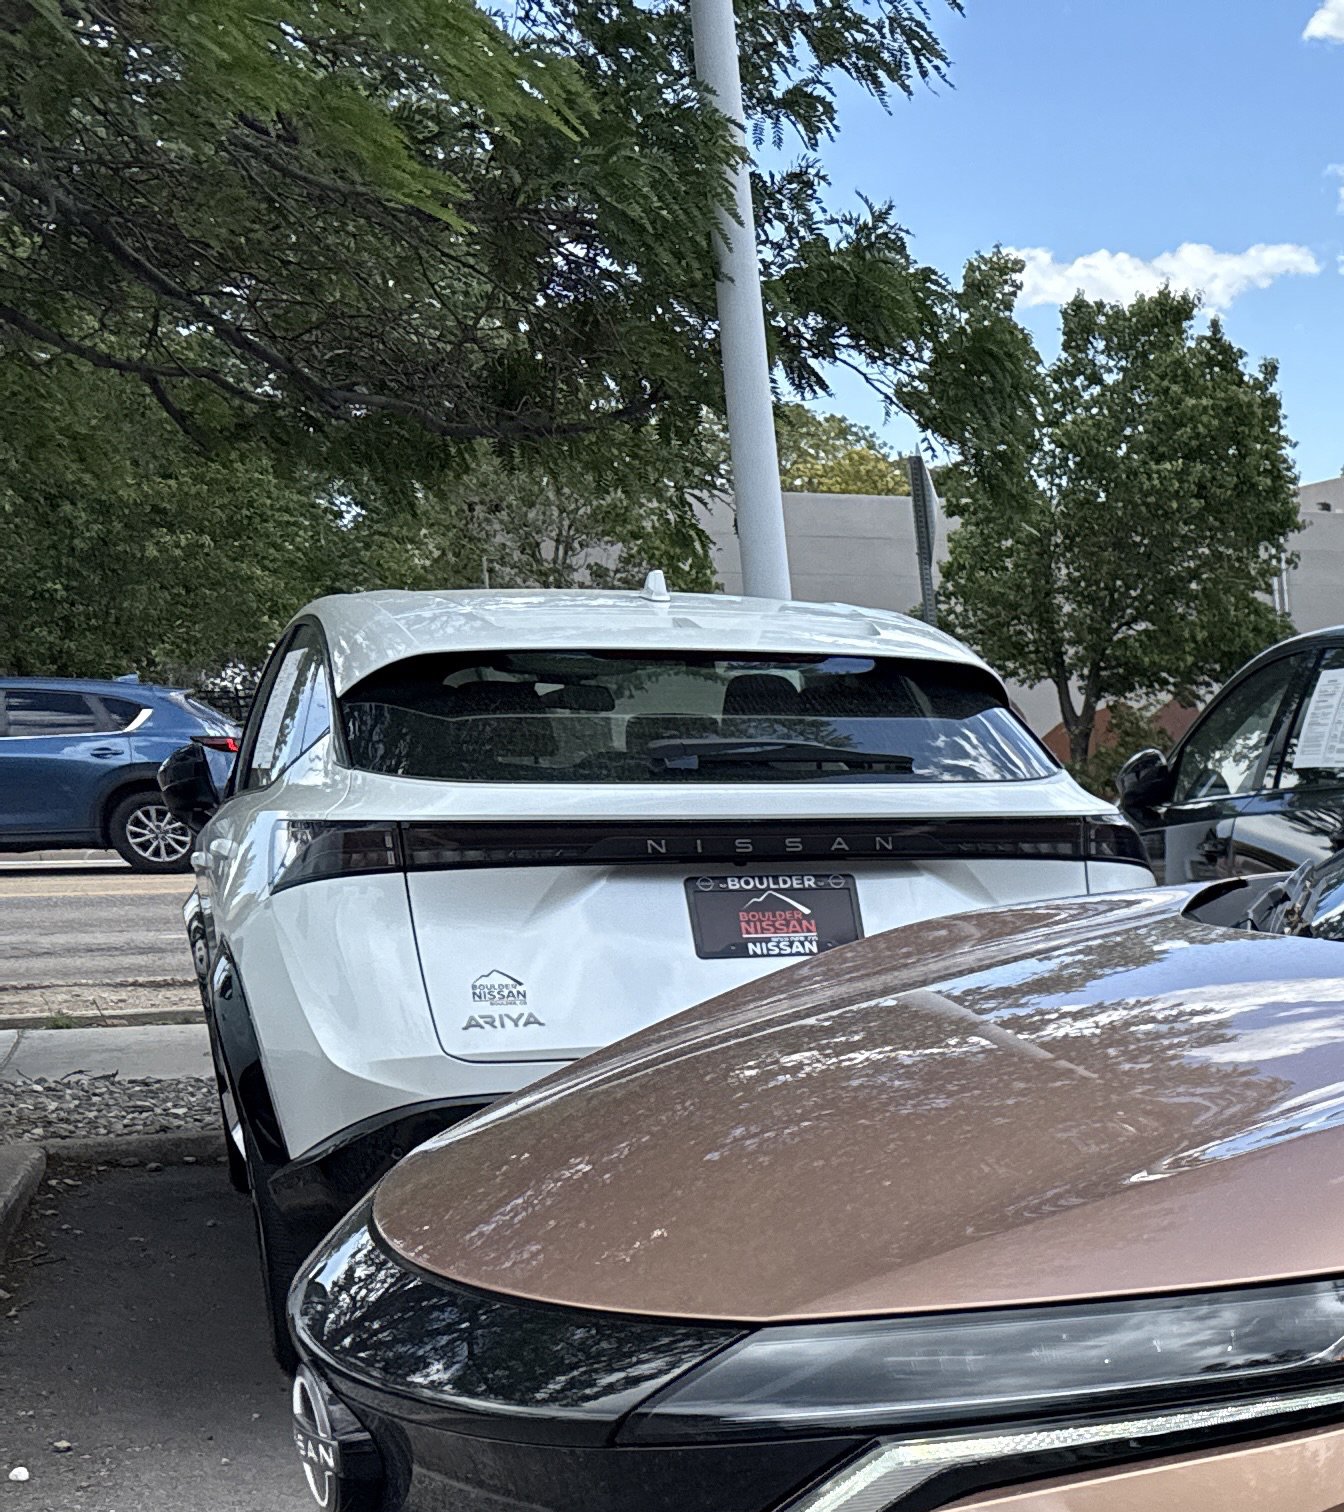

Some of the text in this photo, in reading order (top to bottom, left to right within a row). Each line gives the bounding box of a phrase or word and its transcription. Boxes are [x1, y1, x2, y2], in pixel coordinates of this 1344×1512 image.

[646, 836, 893, 854] NISSAN
[727, 876, 817, 890] BOULDER
[739, 910, 803, 921] BOULDER
[740, 920, 817, 934] NISSAN
[747, 940, 818, 956] NISSAN
[471, 983, 518, 991] BOULDER
[472, 990, 527, 1000] NISSAN
[462, 1012, 546, 1031] ARIYA
